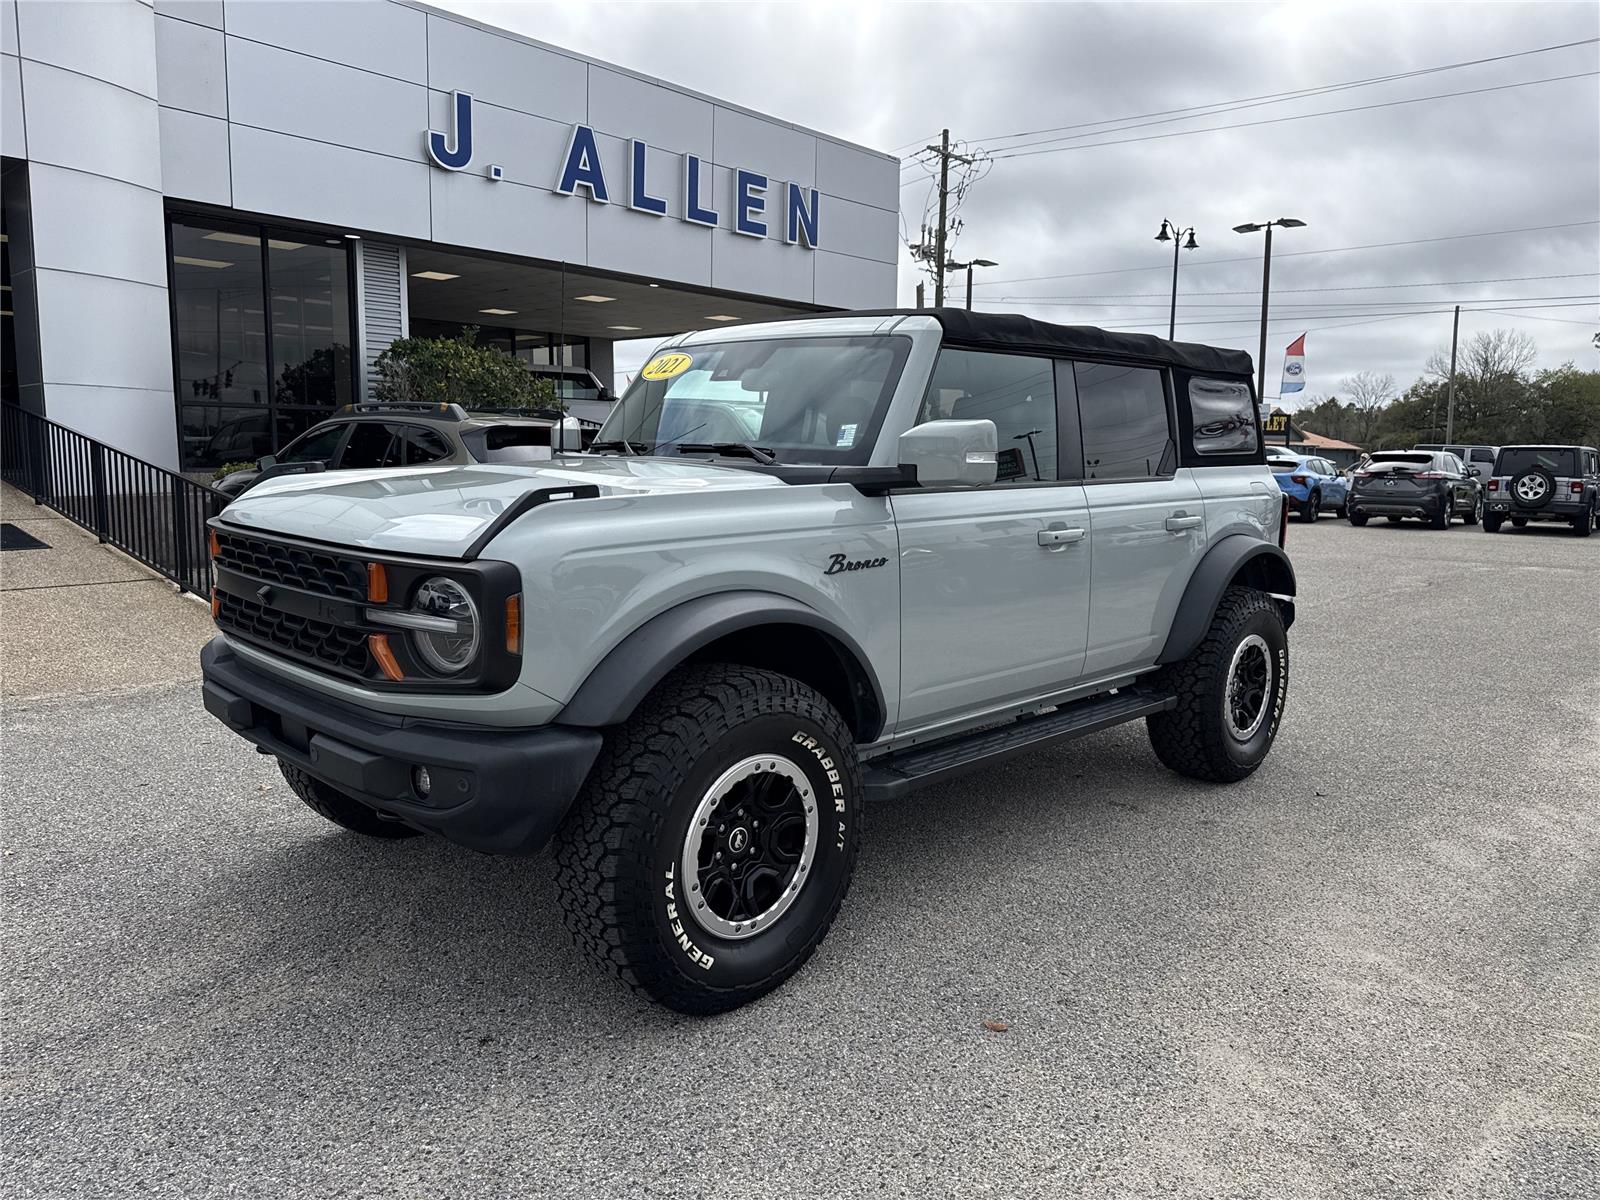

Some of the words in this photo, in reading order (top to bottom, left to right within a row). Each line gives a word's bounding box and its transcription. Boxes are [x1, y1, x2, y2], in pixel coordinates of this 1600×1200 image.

[424, 89, 504, 181] J.
[553, 123, 820, 249] ALLEN
[646, 357, 688, 375] 2021
[823, 553, 889, 575] Bronco
[791, 730, 846, 813] GRABBER
[836, 821, 846, 851] A/T
[664, 861, 715, 970] GENERAL
